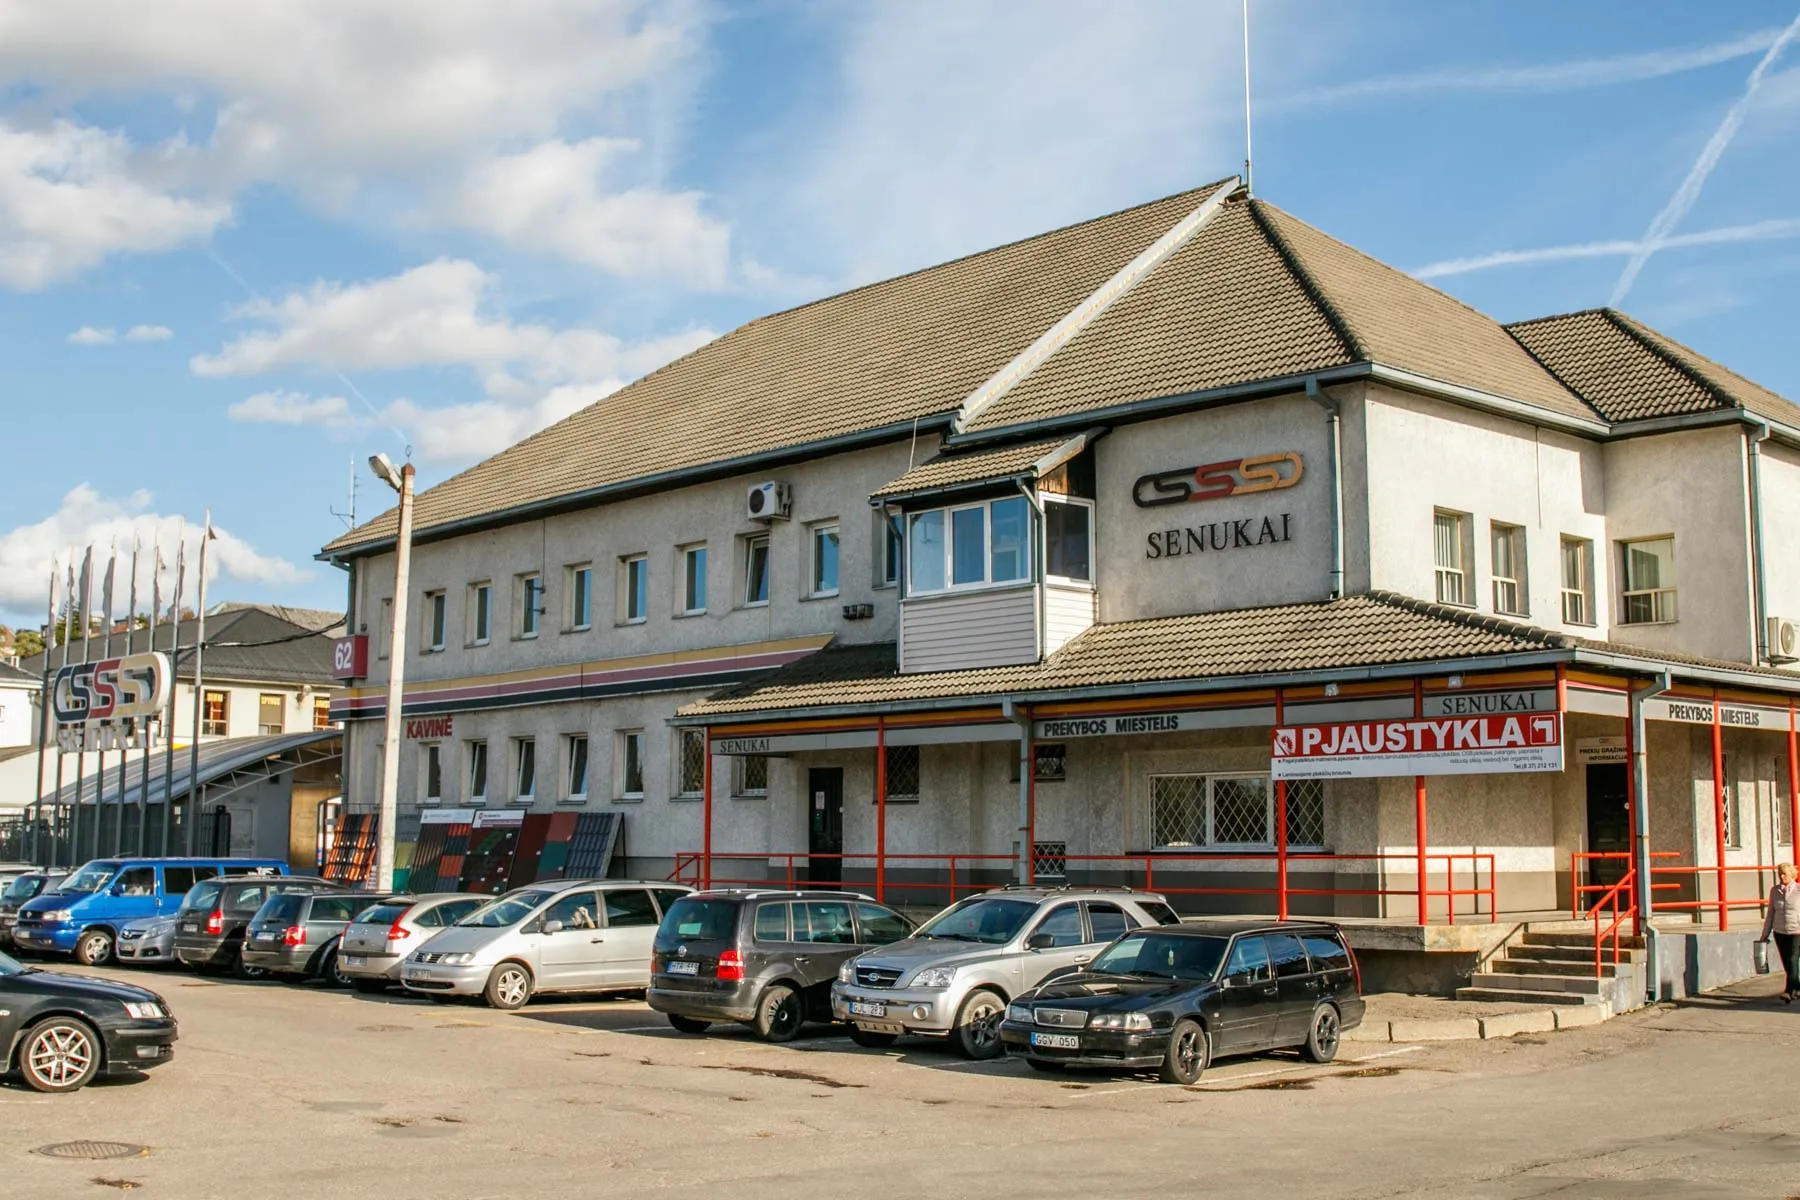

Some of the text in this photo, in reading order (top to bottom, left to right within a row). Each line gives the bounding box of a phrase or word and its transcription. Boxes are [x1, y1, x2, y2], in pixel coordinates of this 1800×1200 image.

[1146, 513, 1292, 560] SENUKAI
[335, 642, 352, 670] 62
[1442, 693, 1537, 714] SENUKAI
[407, 713, 453, 738] KAVINĖ
[1044, 715, 1179, 737] PREKYBOS MIESTELIS
[1669, 704, 1760, 726] PREKYBOS MIESTELIS
[720, 739, 770, 753] SENUKAI
[1302, 717, 1526, 756] PJAUSTYKLA
[1036, 1035, 1076, 1047] GGV 050
